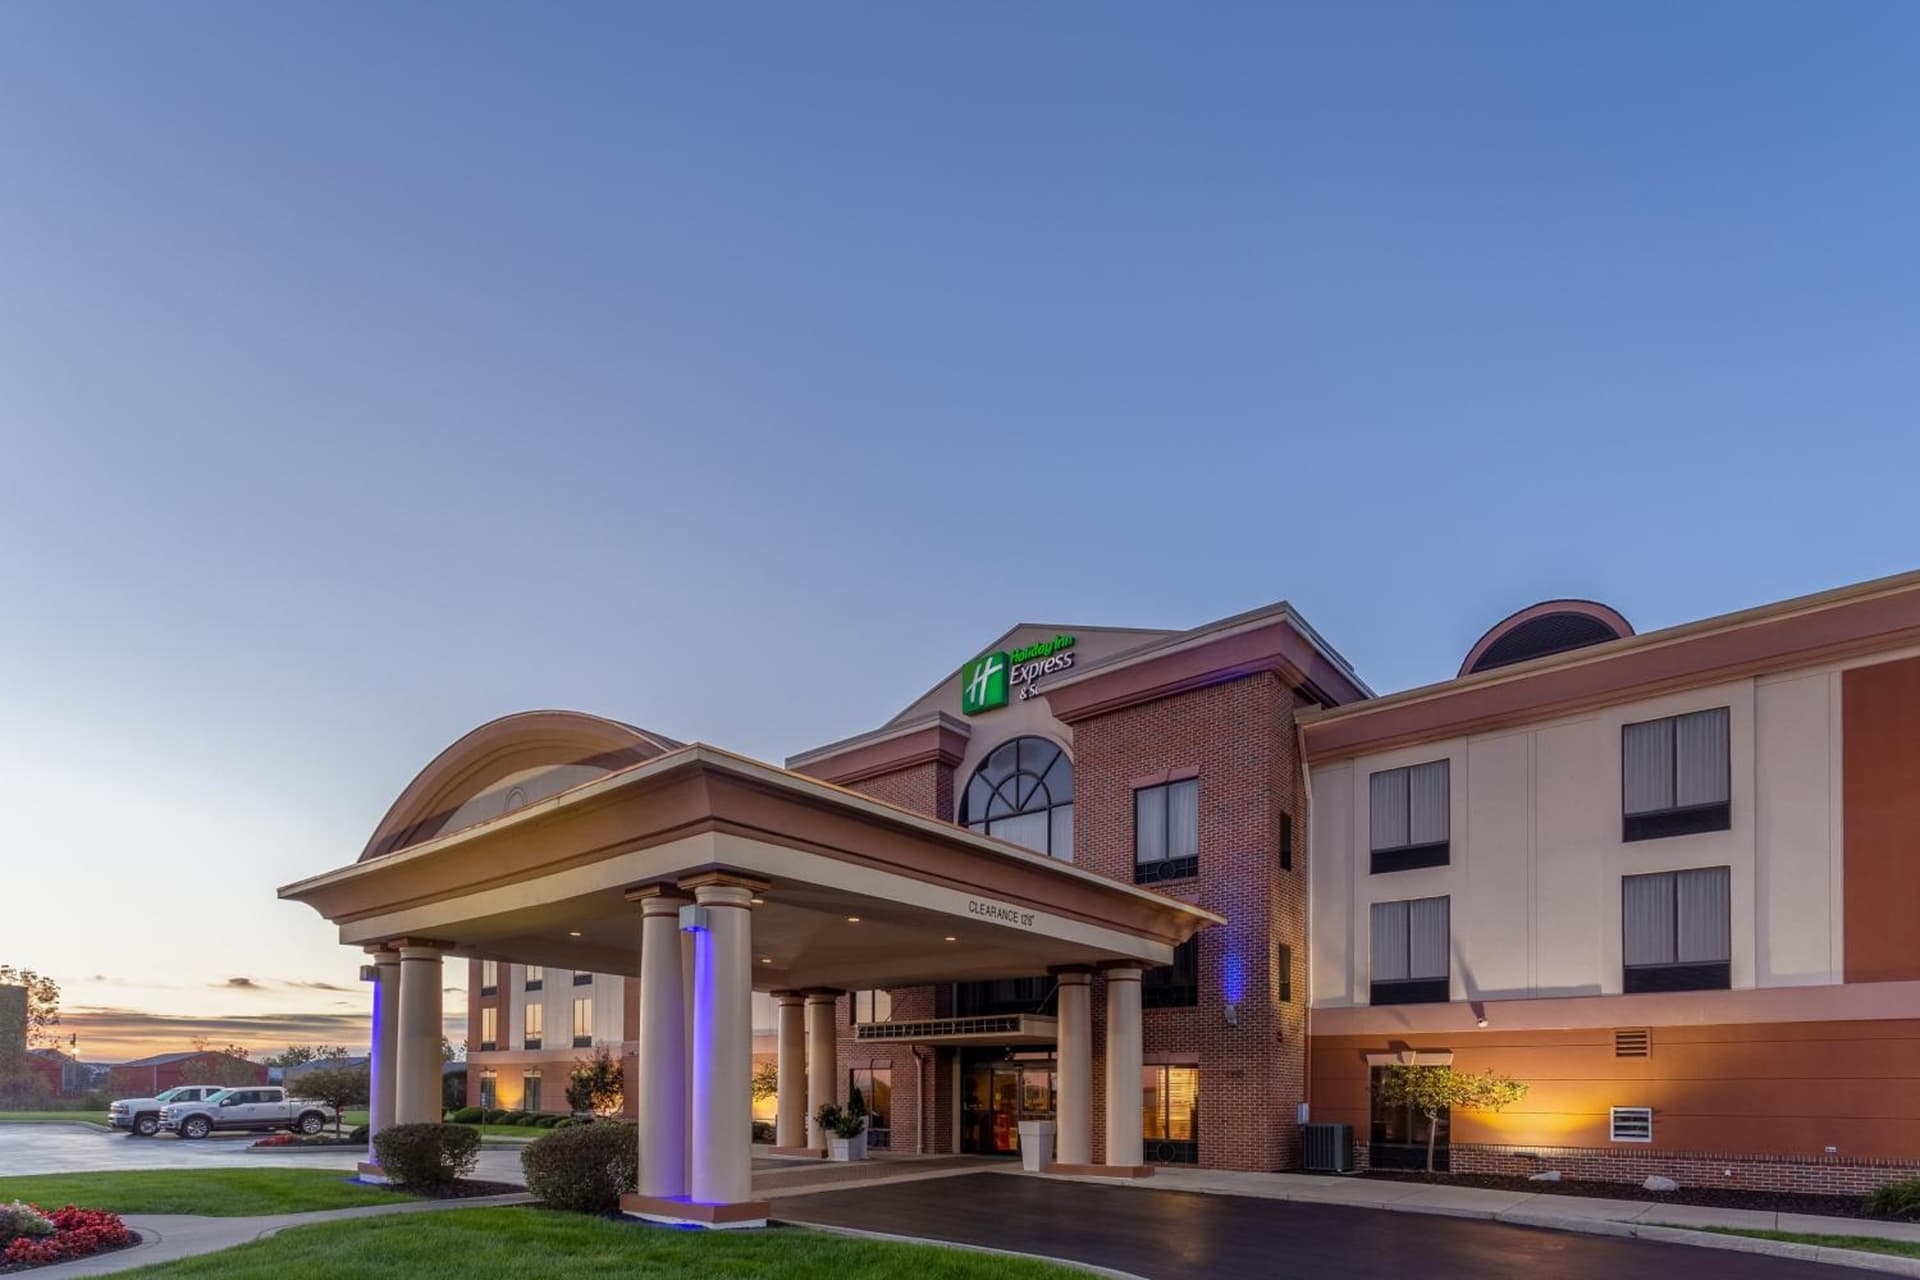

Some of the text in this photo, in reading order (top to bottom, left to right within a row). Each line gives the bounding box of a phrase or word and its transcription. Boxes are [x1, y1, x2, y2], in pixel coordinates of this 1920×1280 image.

[1011, 634, 1074, 665] Holiday Inn
[1010, 651, 1073, 685] Express
[1019, 687, 1028, 700] &
[968, 900, 1018, 924] CLEARANCE
